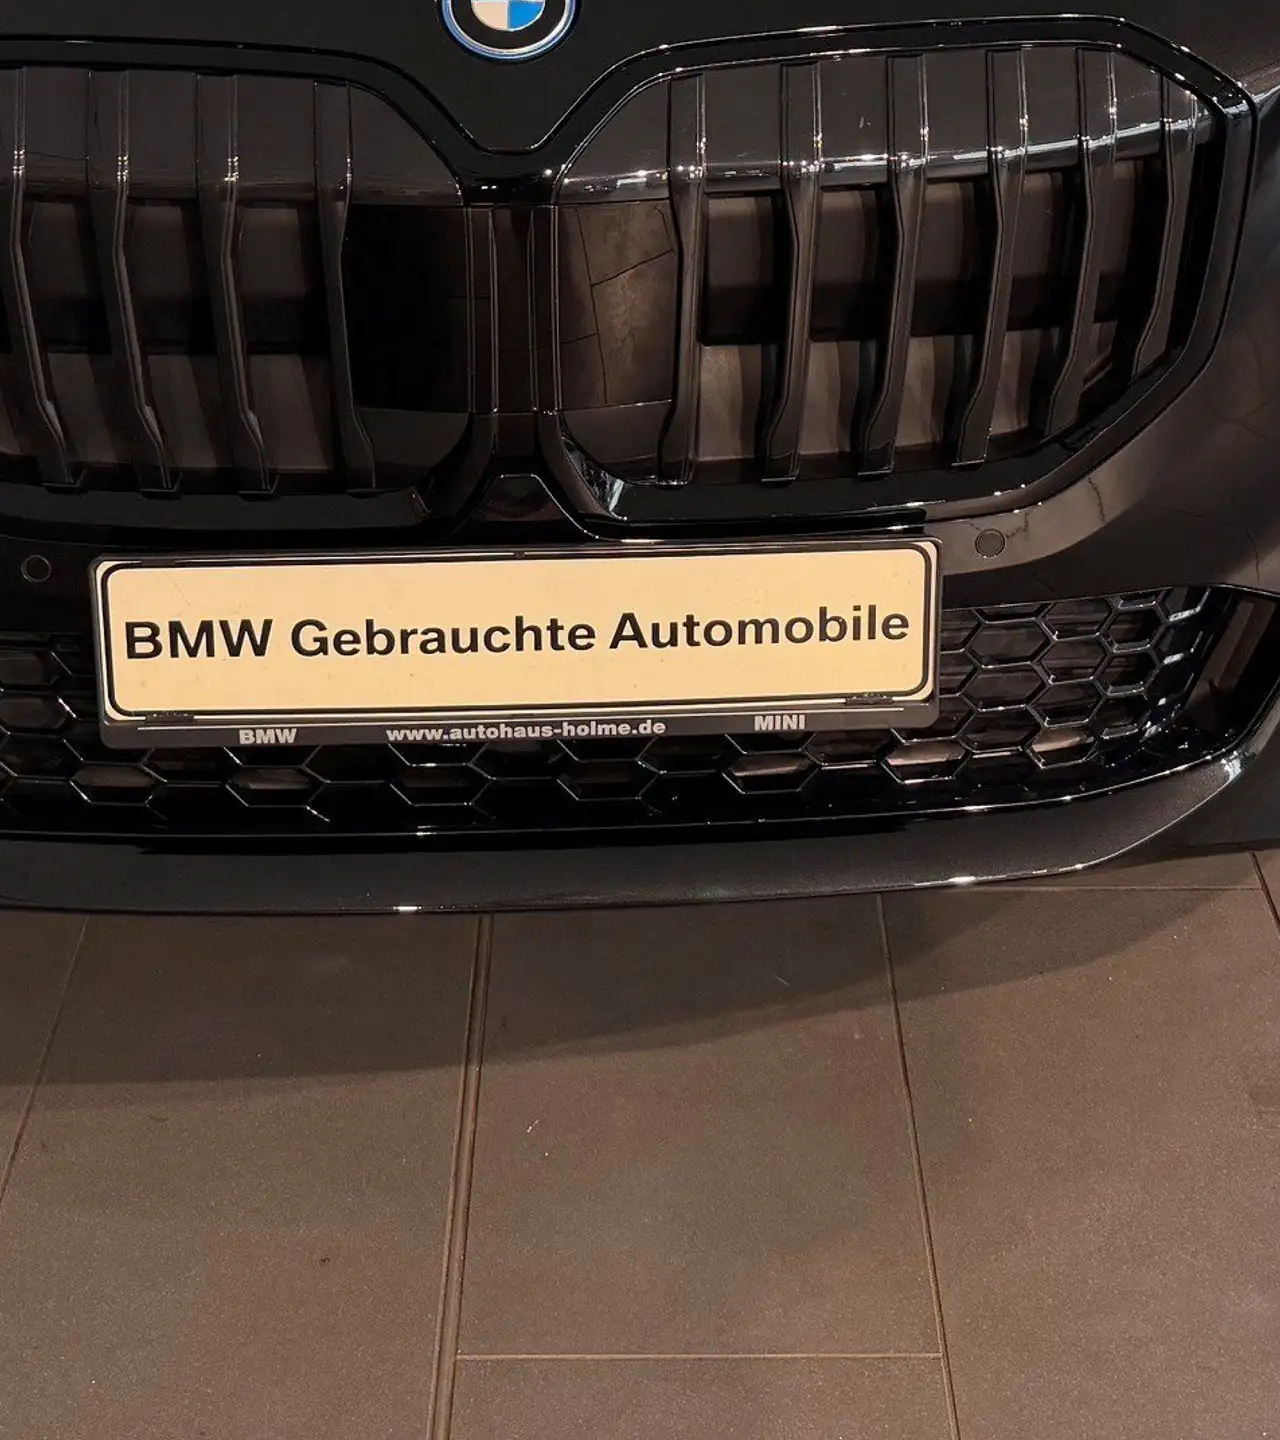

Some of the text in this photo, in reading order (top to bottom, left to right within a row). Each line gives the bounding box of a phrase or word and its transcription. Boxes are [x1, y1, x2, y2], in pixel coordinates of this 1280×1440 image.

[125, 604, 909, 659] BMW Gebrauchte Automobile
[239, 714, 806, 744] BMW www.autohaus-holme.de MINI
